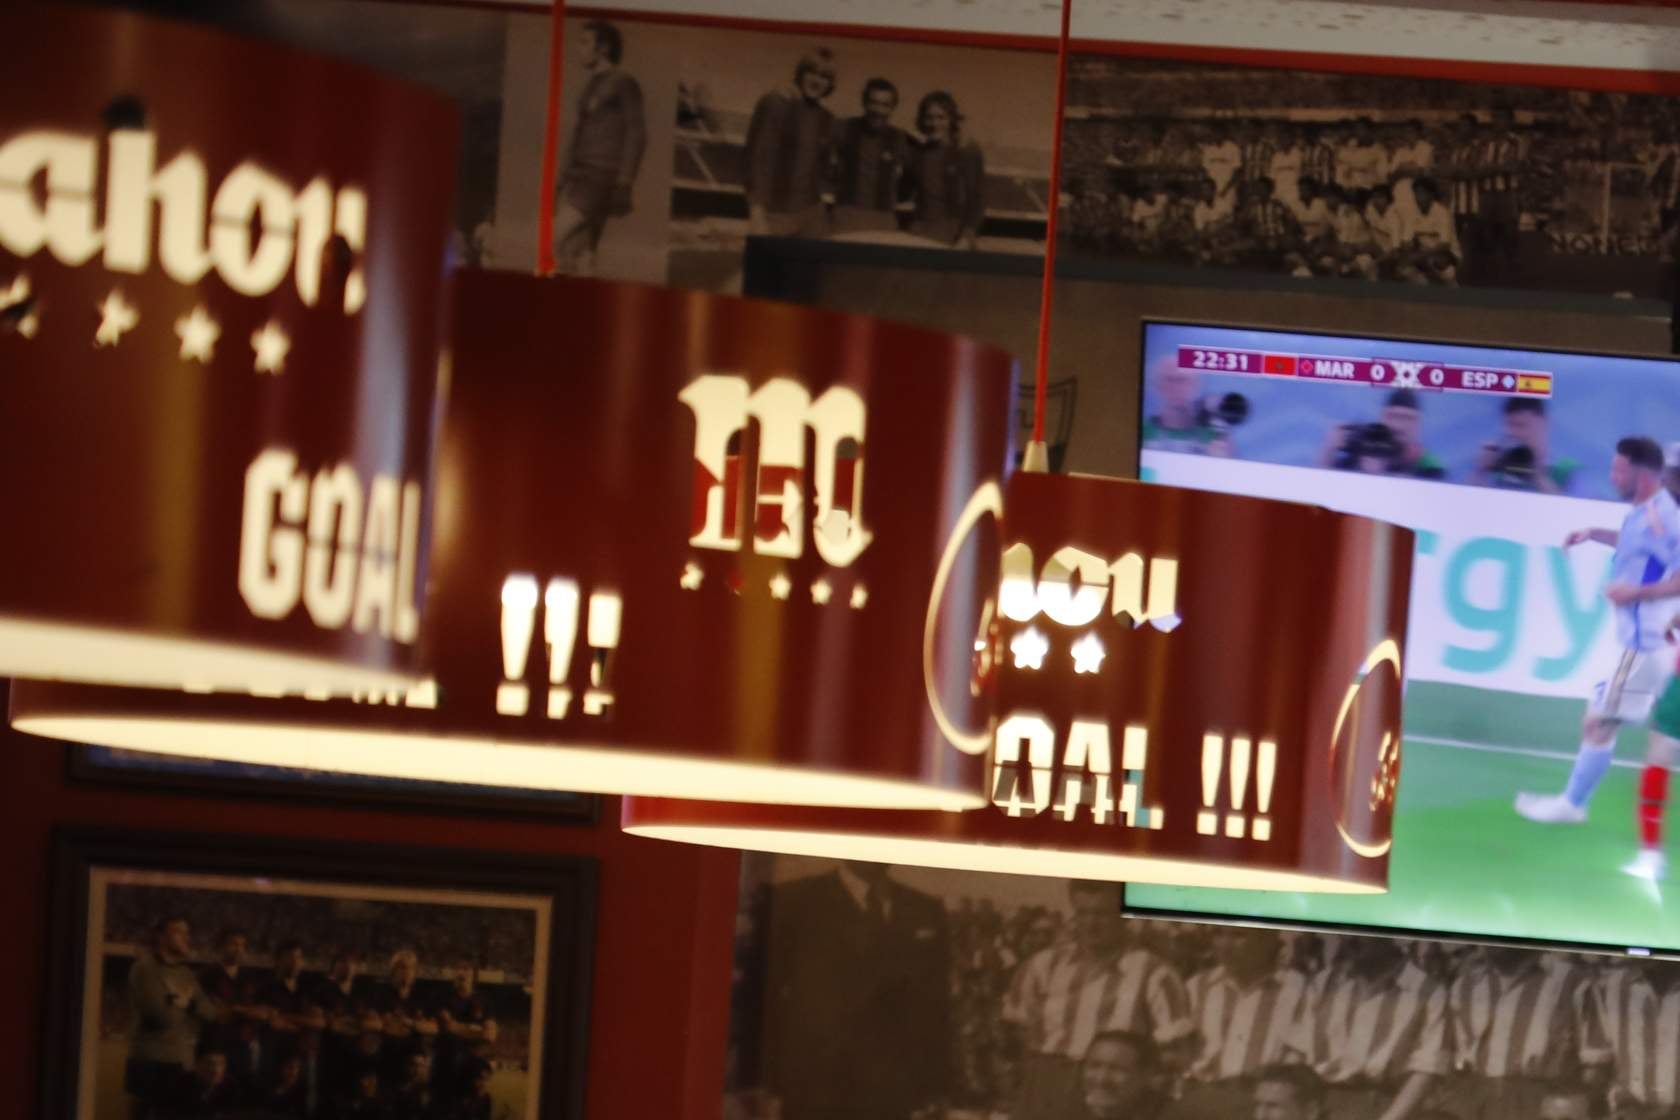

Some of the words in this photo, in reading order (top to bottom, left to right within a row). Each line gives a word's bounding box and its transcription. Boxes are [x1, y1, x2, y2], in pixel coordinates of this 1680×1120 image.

[1193, 350, 1248, 371] 22:31
[1314, 360, 1355, 379] MAR
[1371, 364, 1385, 381] 0
[1430, 367, 1444, 385] 0
[1462, 371, 1498, 389] ESP
[231, 446, 420, 644] GOAL
[1197, 733, 1277, 842] !!!
